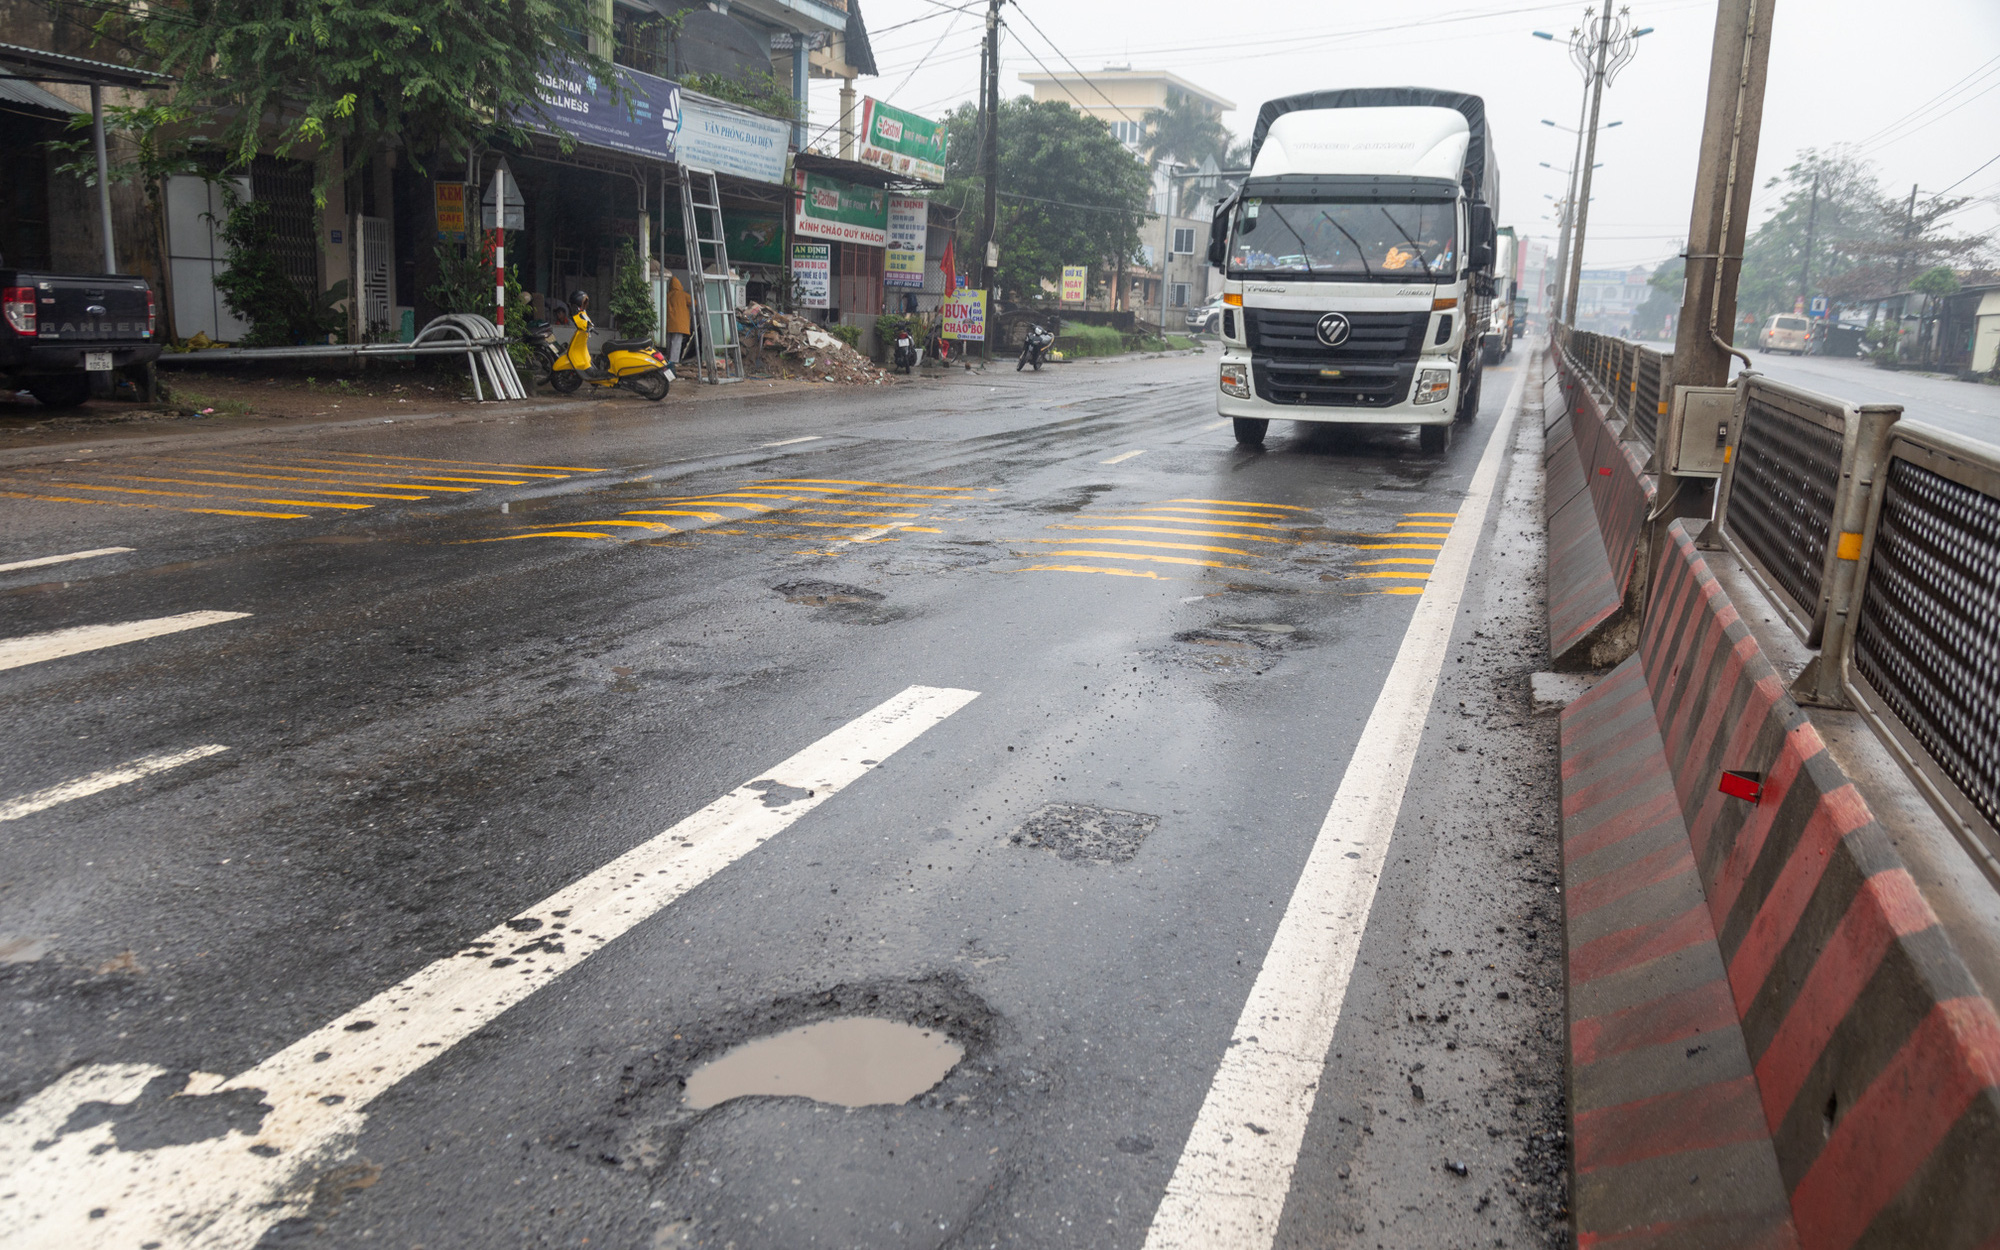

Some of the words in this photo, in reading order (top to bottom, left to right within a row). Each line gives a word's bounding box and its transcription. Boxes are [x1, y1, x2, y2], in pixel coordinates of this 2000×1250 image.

[535, 72, 582, 95] SIBERIAN
[534, 86, 589, 113] WELLNESS
[705, 121, 719, 134] VĂN
[721, 126, 745, 143] PHÒNG
[746, 134, 757, 146] ĐẠI
[758, 137, 773, 149] DIỆN
[882, 119, 902, 140] Castrol
[440, 186, 461, 200] KEM
[817, 190, 838, 208] Castrol
[891, 200, 902, 208] AN
[904, 201, 923, 210] ĐỊNH
[799, 220, 819, 232] KÍNH
[821, 224, 842, 236] CHÀO
[844, 228, 858, 239] QUÝ
[860, 231, 884, 242] KHÁCH
[808, 246, 826, 255] ĐỊNH
[1065, 280, 1082, 288] NGÀY
[945, 300, 968, 319] BÚN
[40, 322, 146, 332] RANGER
[944, 321, 968, 333] CHÁO
[971, 322, 983, 334] BÒ
